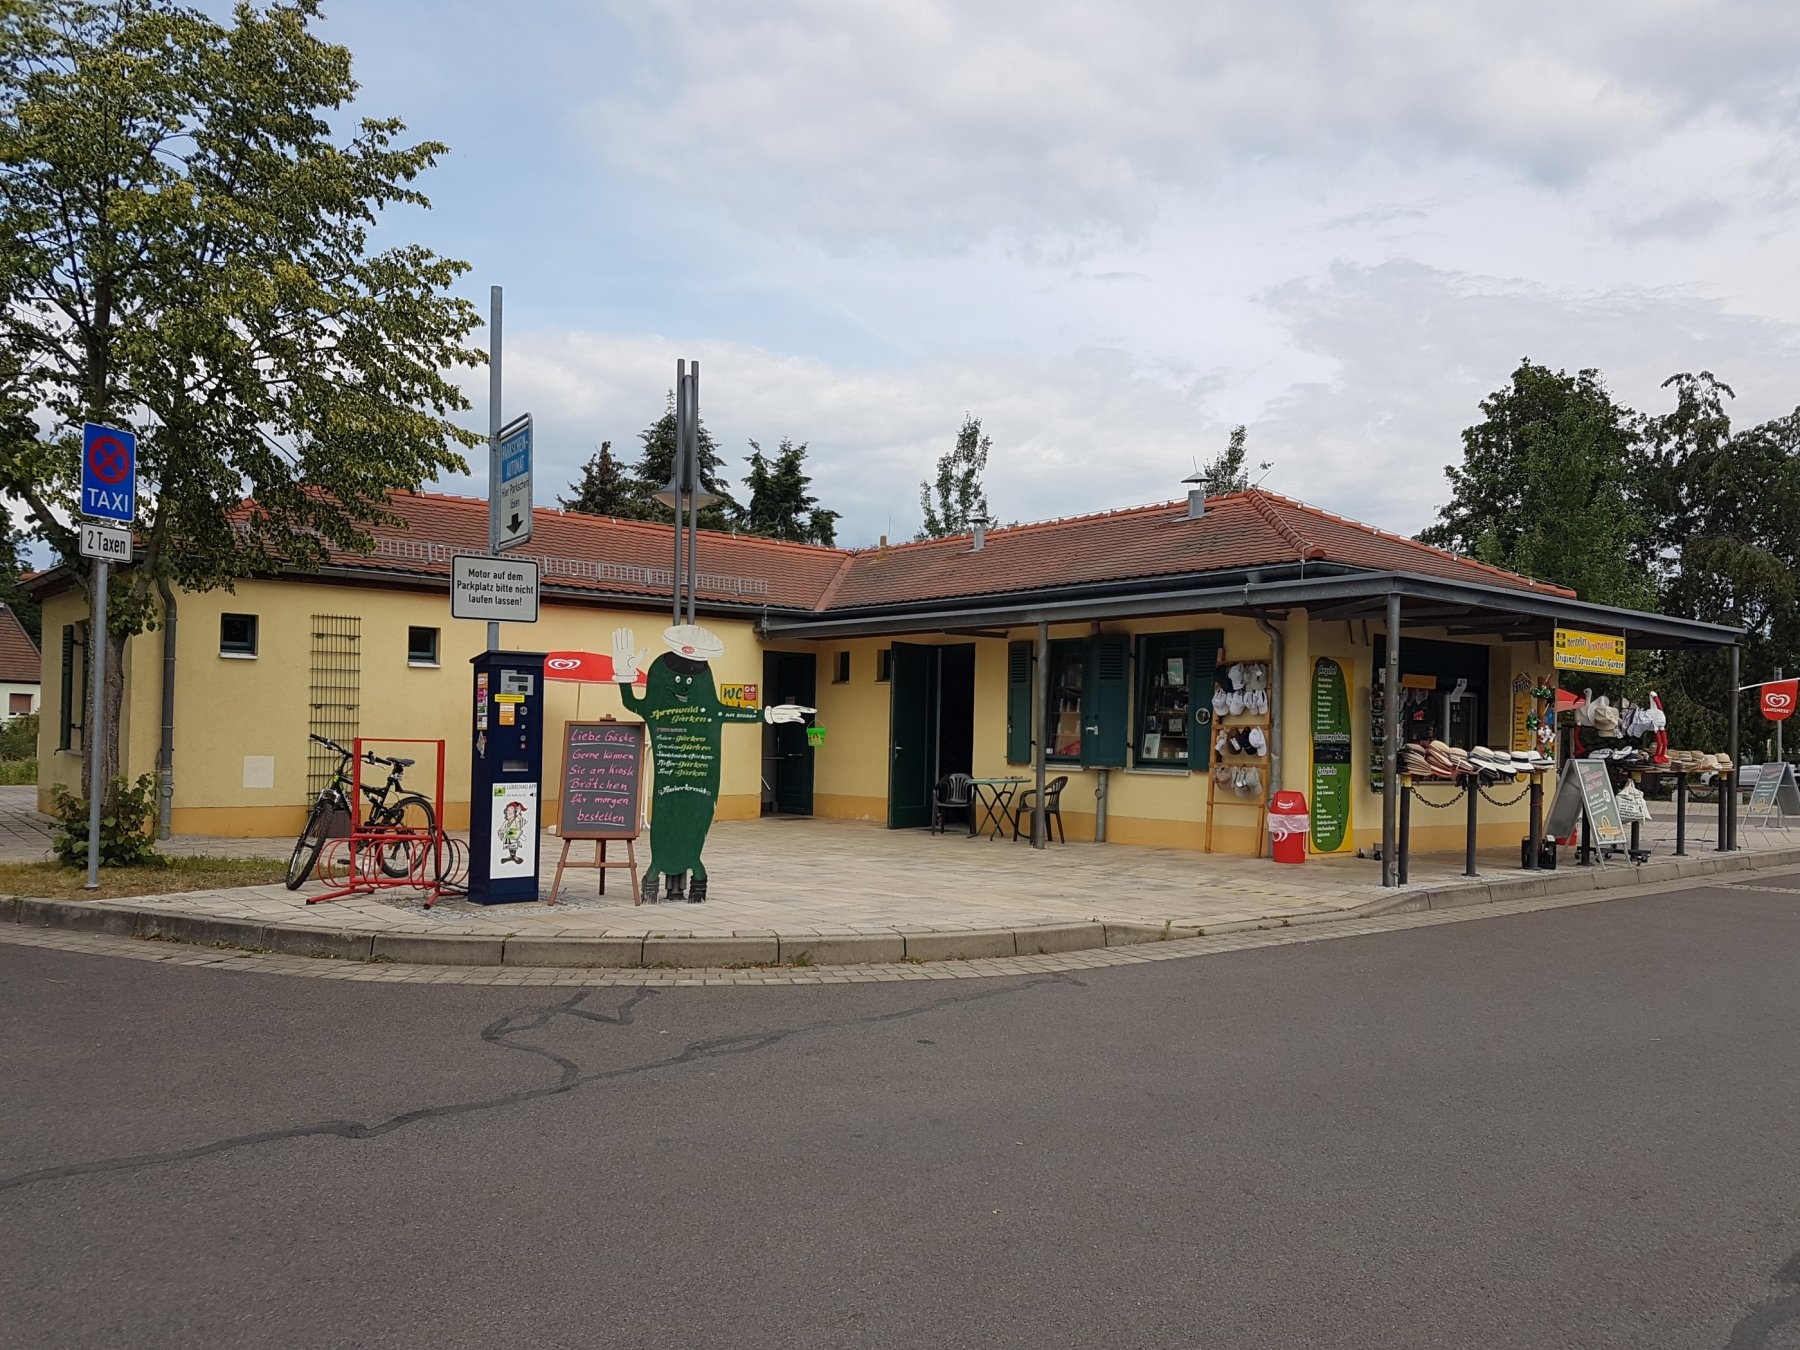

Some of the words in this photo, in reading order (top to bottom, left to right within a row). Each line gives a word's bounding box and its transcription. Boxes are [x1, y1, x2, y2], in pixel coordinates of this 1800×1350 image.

[87, 487, 129, 513] TAXI
[87, 530, 94, 549] 2
[97, 531, 126, 555] Taxen
[468, 568, 490, 579] Motor
[493, 571, 506, 580] auf
[507, 572, 523, 581] dem
[457, 580, 494, 593] Parkplatz
[495, 583, 513, 593] bitte
[515, 584, 534, 594] nicht
[468, 593, 493, 604] laufen
[495, 596, 522, 606] lassen!
[1555, 651, 1577, 665] Original
[723, 687, 743, 699] WC
[571, 729, 601, 741] Liebe
[572, 748, 600, 760] Gerne
[569, 764, 586, 775] Sie
[608, 763, 634, 776] Kiosk
[570, 777, 628, 791] Brötchen
[570, 793, 587, 806] für
[594, 797, 629, 809] morgen
[576, 808, 625, 824] bestellen
